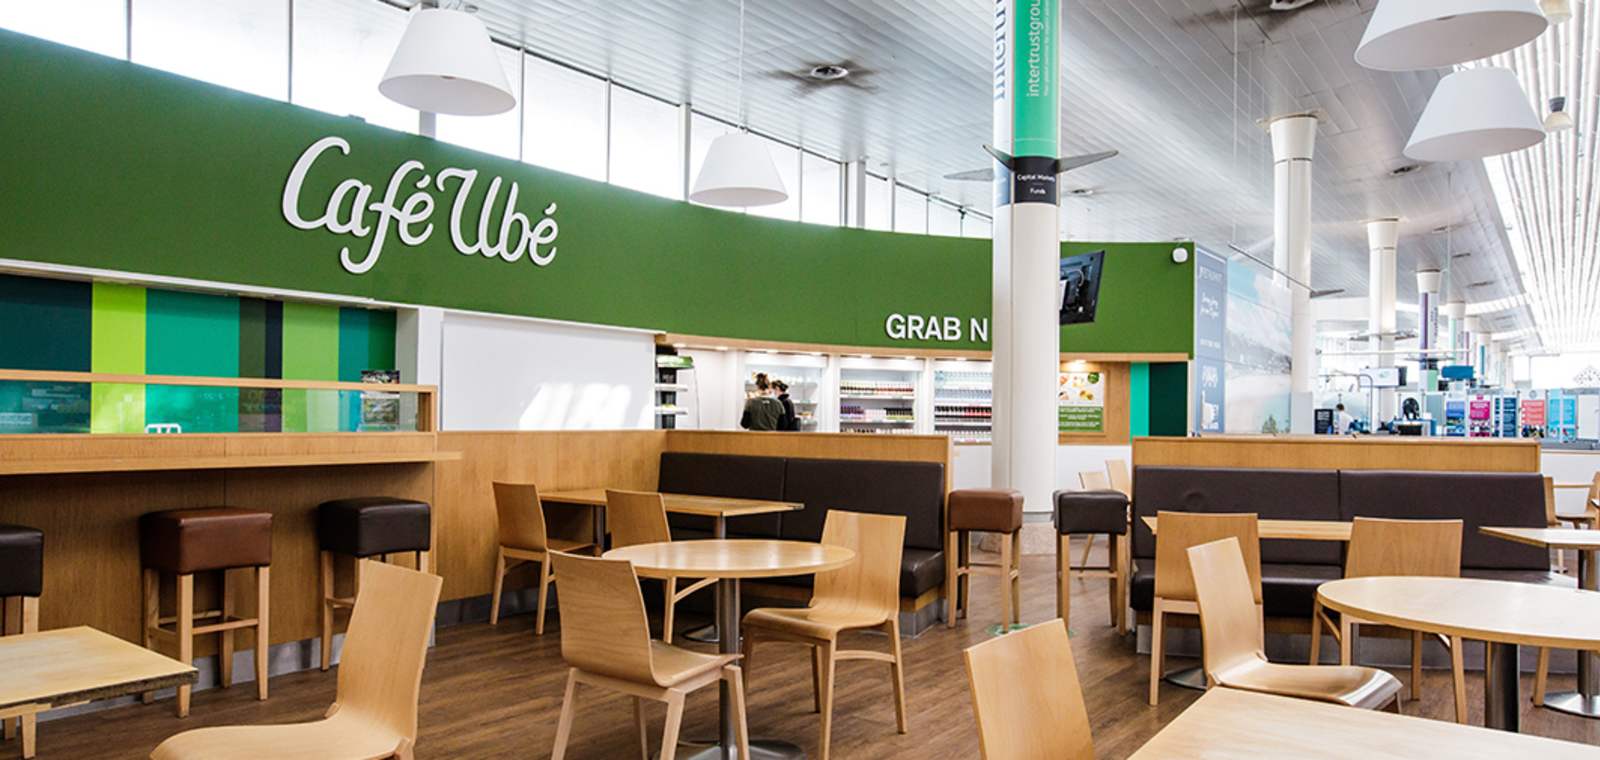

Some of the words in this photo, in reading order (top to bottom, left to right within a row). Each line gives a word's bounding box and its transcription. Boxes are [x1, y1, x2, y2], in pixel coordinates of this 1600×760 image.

[282, 136, 433, 275] Café
[436, 167, 558, 267] Ubé
[885, 313, 962, 342] GRAB
[970, 317, 989, 343] N
